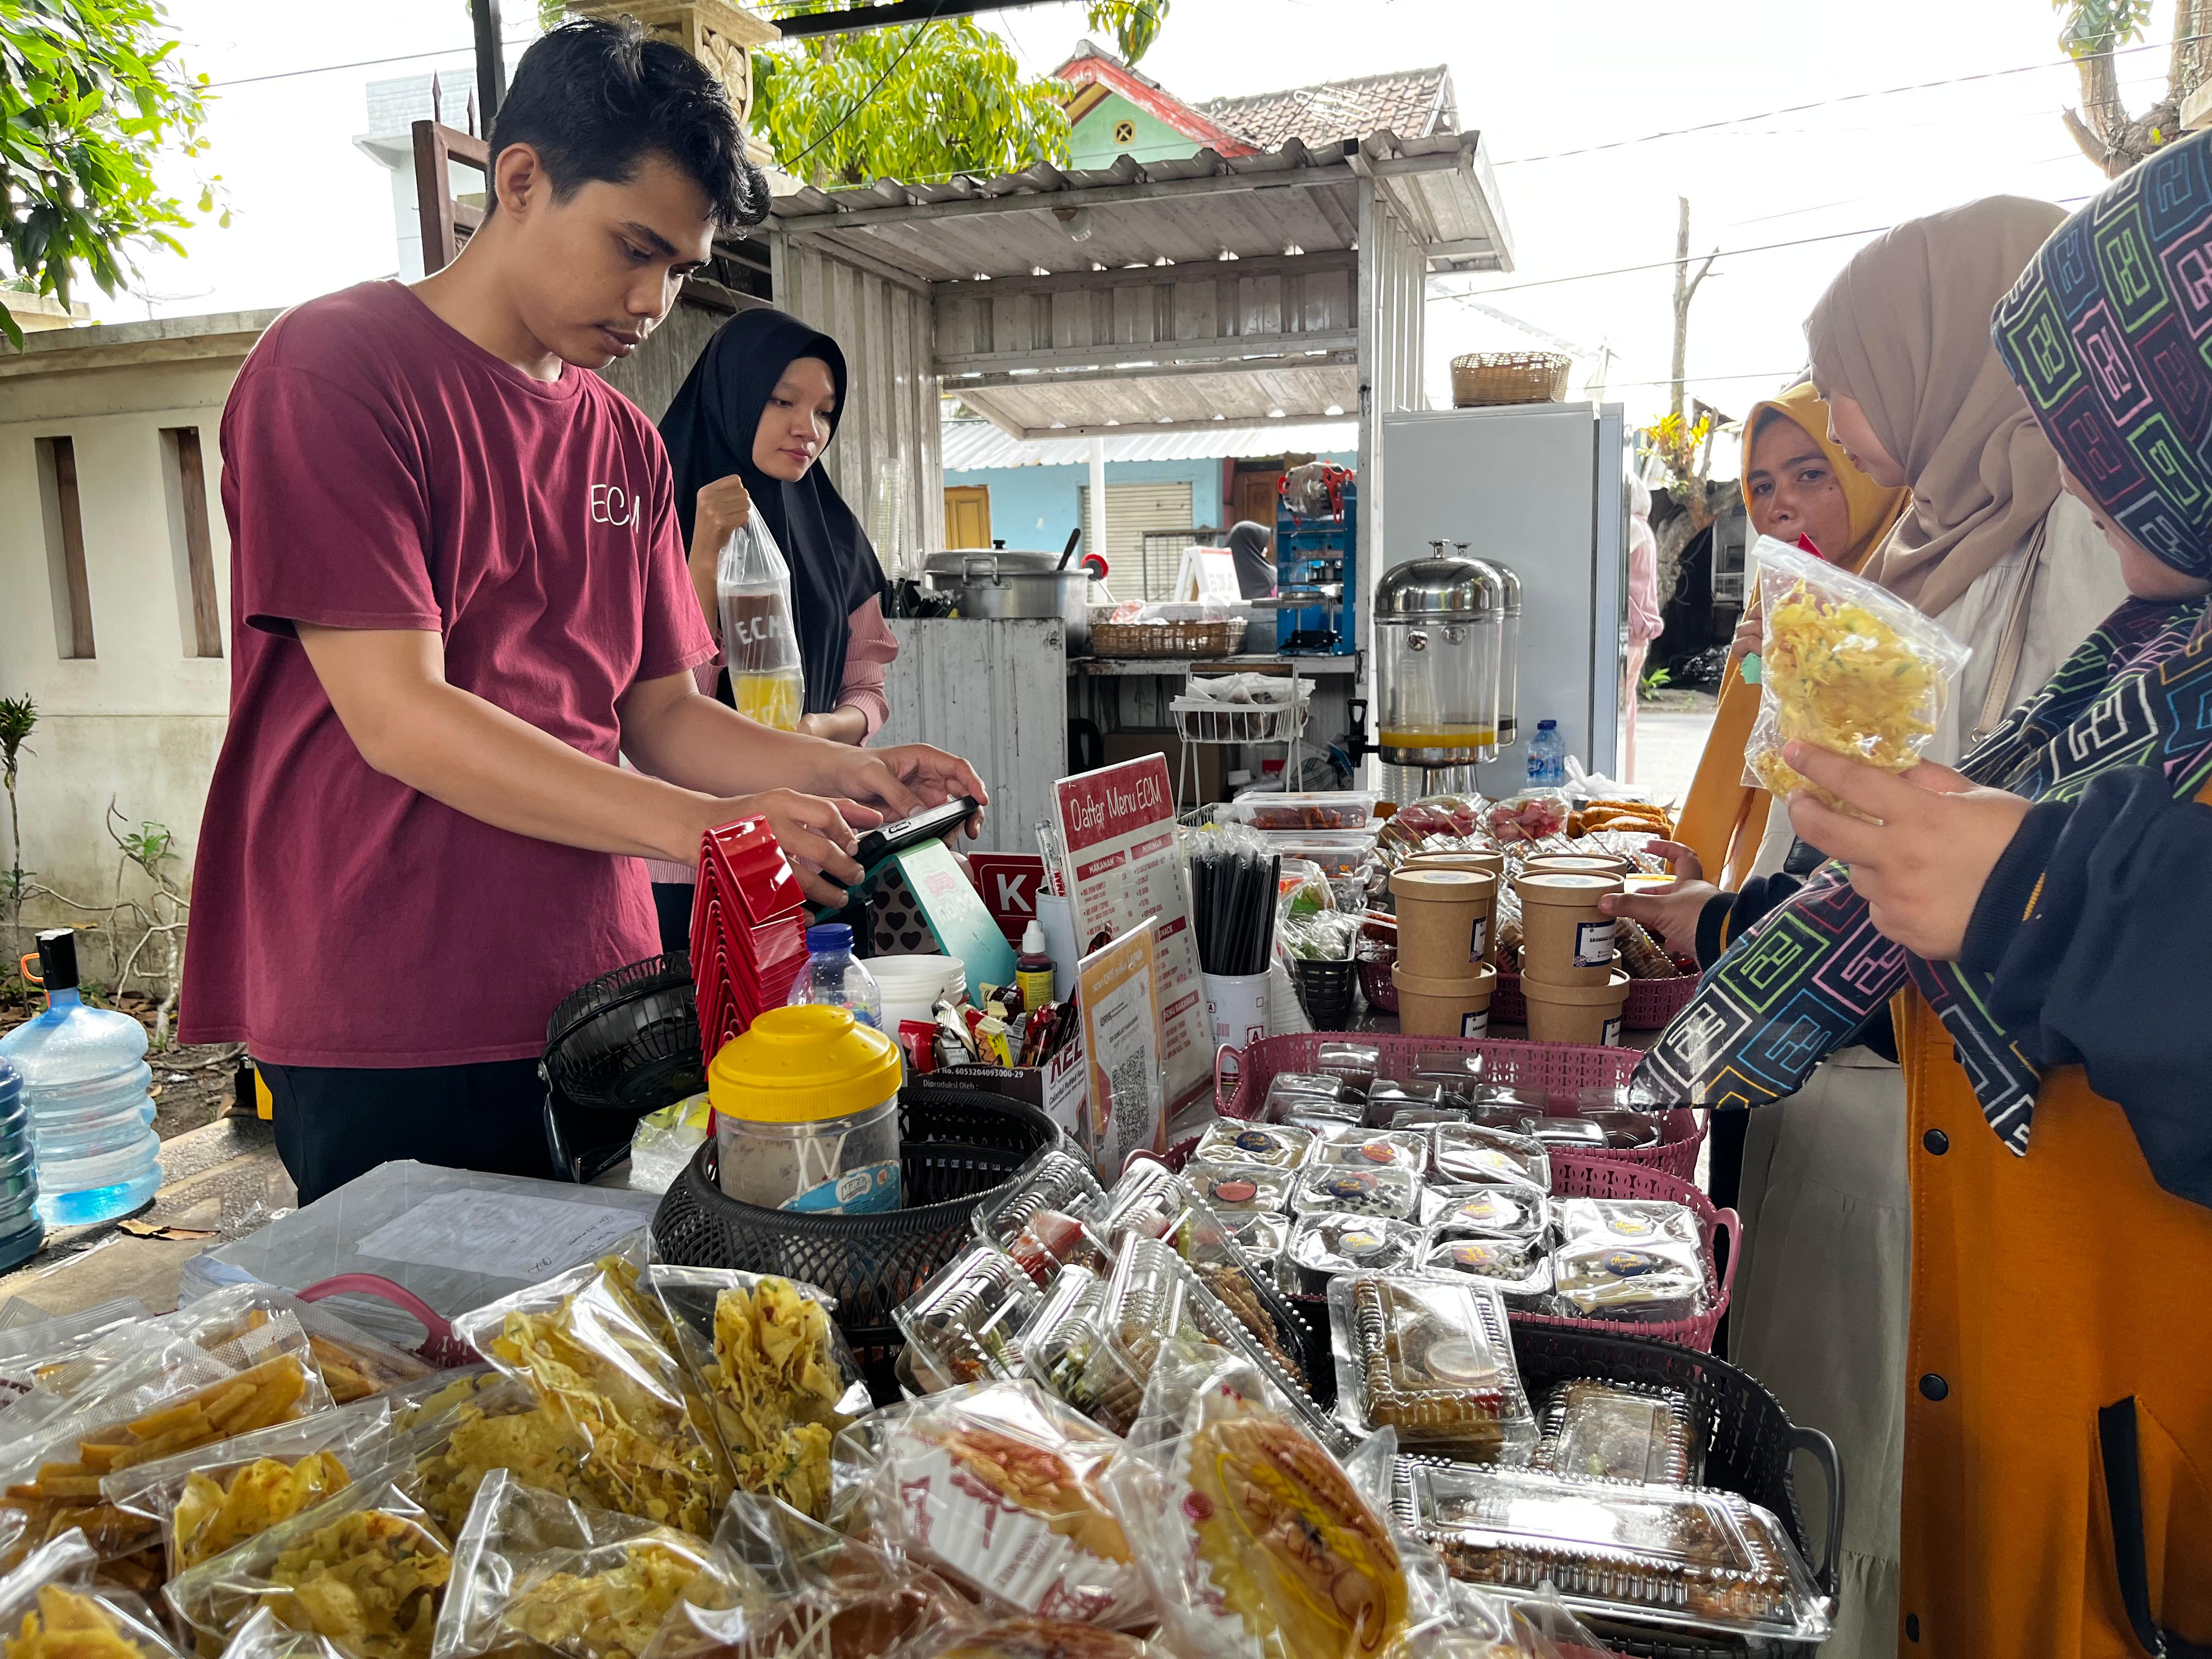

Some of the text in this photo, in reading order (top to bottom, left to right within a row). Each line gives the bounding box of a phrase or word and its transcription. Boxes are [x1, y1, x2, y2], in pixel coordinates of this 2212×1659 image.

[736, 615, 784, 644] ECM
[1070, 774, 1163, 831] Daftar Menu ECM
[1089, 857, 1115, 873] MAKANAN
[996, 873, 1032, 912] K
[1175, 994, 1195, 1011] BAKARAN
[955, 1068, 1024, 1079] 6053204093000-29
[923, 1079, 958, 1088] Diproduksi
[1611, 1255, 1637, 1265] thank
